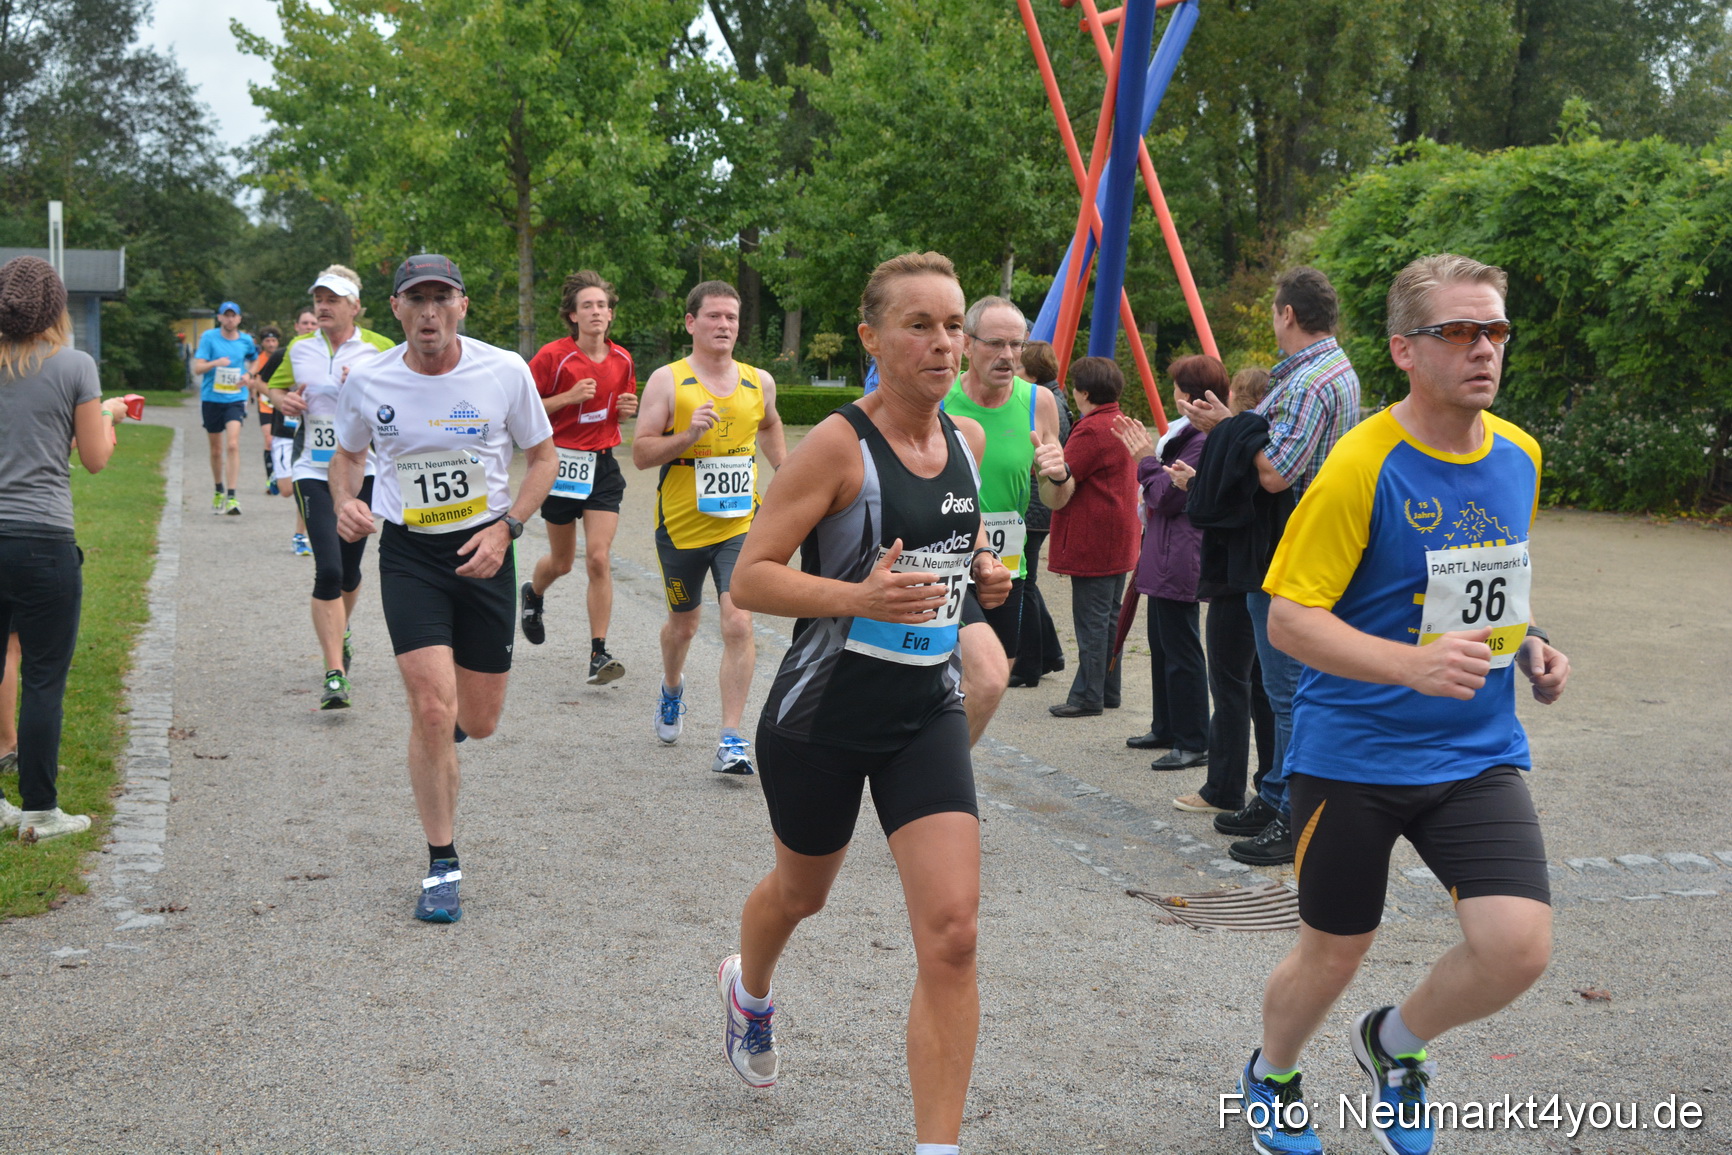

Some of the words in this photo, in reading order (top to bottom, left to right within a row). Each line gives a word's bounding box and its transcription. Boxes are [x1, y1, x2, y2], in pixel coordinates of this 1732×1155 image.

[315, 428, 336, 447] 33
[377, 425, 399, 433] PARTL
[397, 463, 424, 472] PARTL
[425, 459, 468, 471] Neumarkt
[558, 460, 589, 481] 668
[414, 470, 470, 504] 153
[703, 471, 750, 495] 2802
[419, 505, 473, 525] Johannes
[1413, 511, 1437, 520] Jahre
[876, 552, 920, 567] PRTL
[922, 558, 963, 570] Neumarkt
[1431, 562, 1470, 576] PARTL
[1472, 558, 1522, 573] Neumarkt
[1462, 576, 1507, 625] 36
[902, 631, 931, 651] Eva
